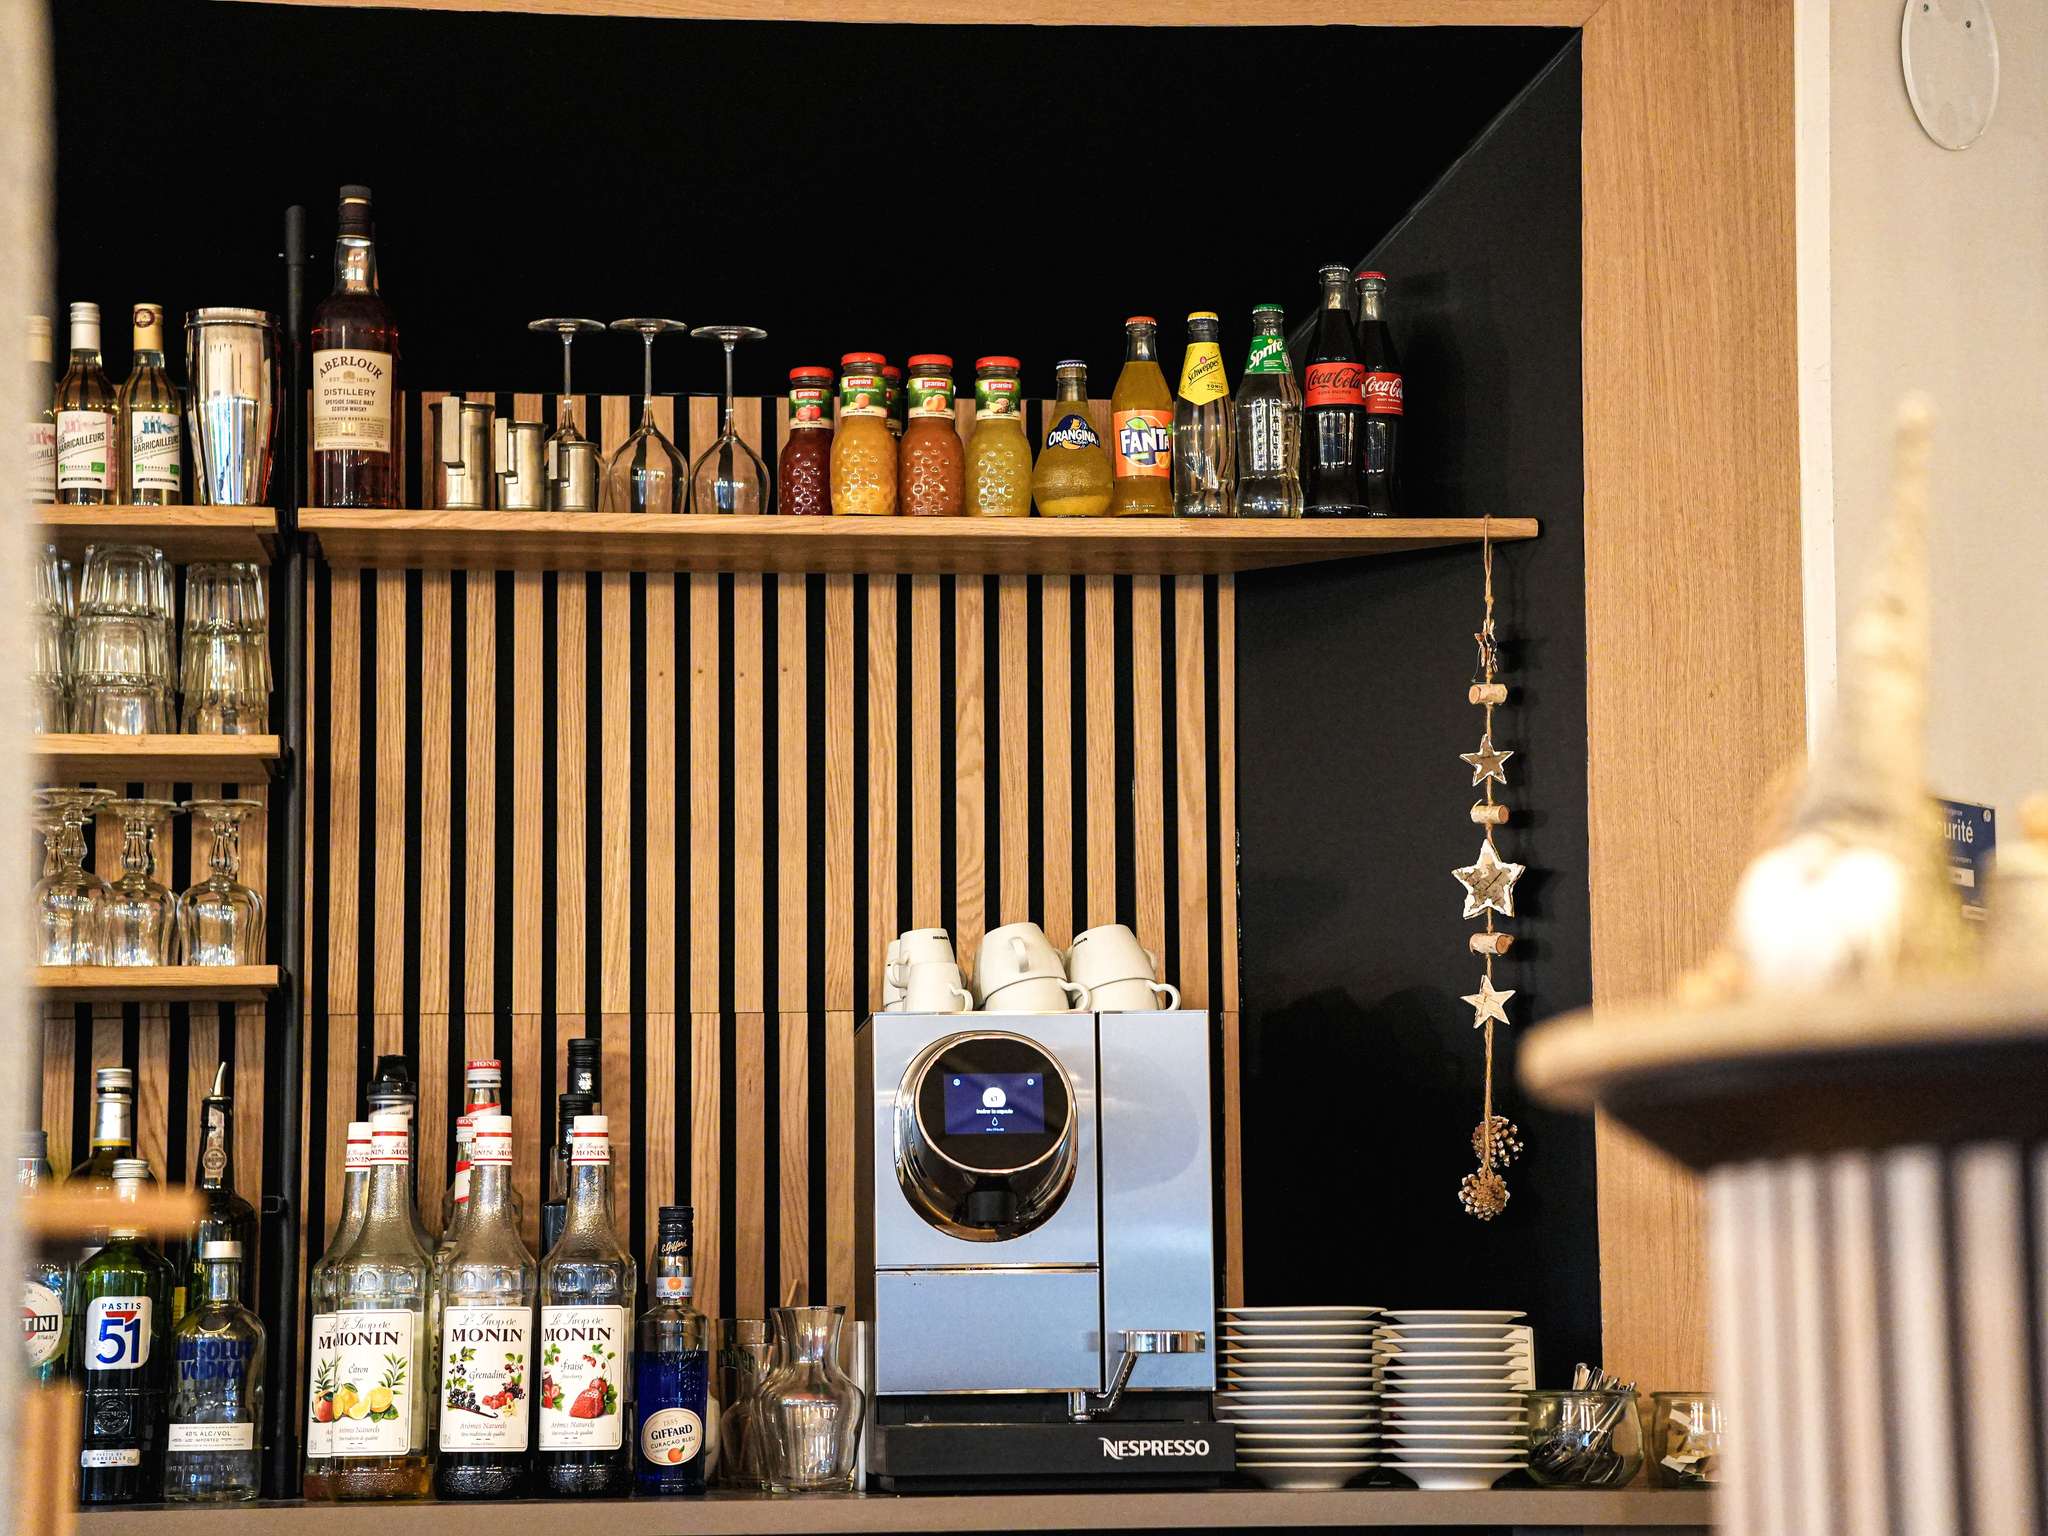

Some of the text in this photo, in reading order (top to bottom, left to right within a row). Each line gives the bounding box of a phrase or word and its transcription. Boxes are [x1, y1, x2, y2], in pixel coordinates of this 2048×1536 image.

[1249, 340, 1284, 369] Sprite
[320, 355, 383, 379] ABERLOUR
[1188, 359, 1220, 382] Schweppes
[324, 388, 376, 397] DISTILLERY
[1048, 430, 1097, 446] ORANGINA
[101, 1302, 141, 1310] PASTIS
[22, 1315, 57, 1332] TINI
[96, 1319, 141, 1364] 51
[336, 1332, 400, 1346] MONIN
[452, 1328, 523, 1342] MONIN
[544, 1328, 612, 1341] MONIN
[561, 1359, 584, 1373] Fraise
[468, 1367, 507, 1381] Grenadine
[200, 1430, 231, 1438] ALC/VOL
[651, 1424, 693, 1440] GIFFARD
[651, 1438, 681, 1449] CURAÇAO
[1098, 1437, 1210, 1460] NESPRESSO
